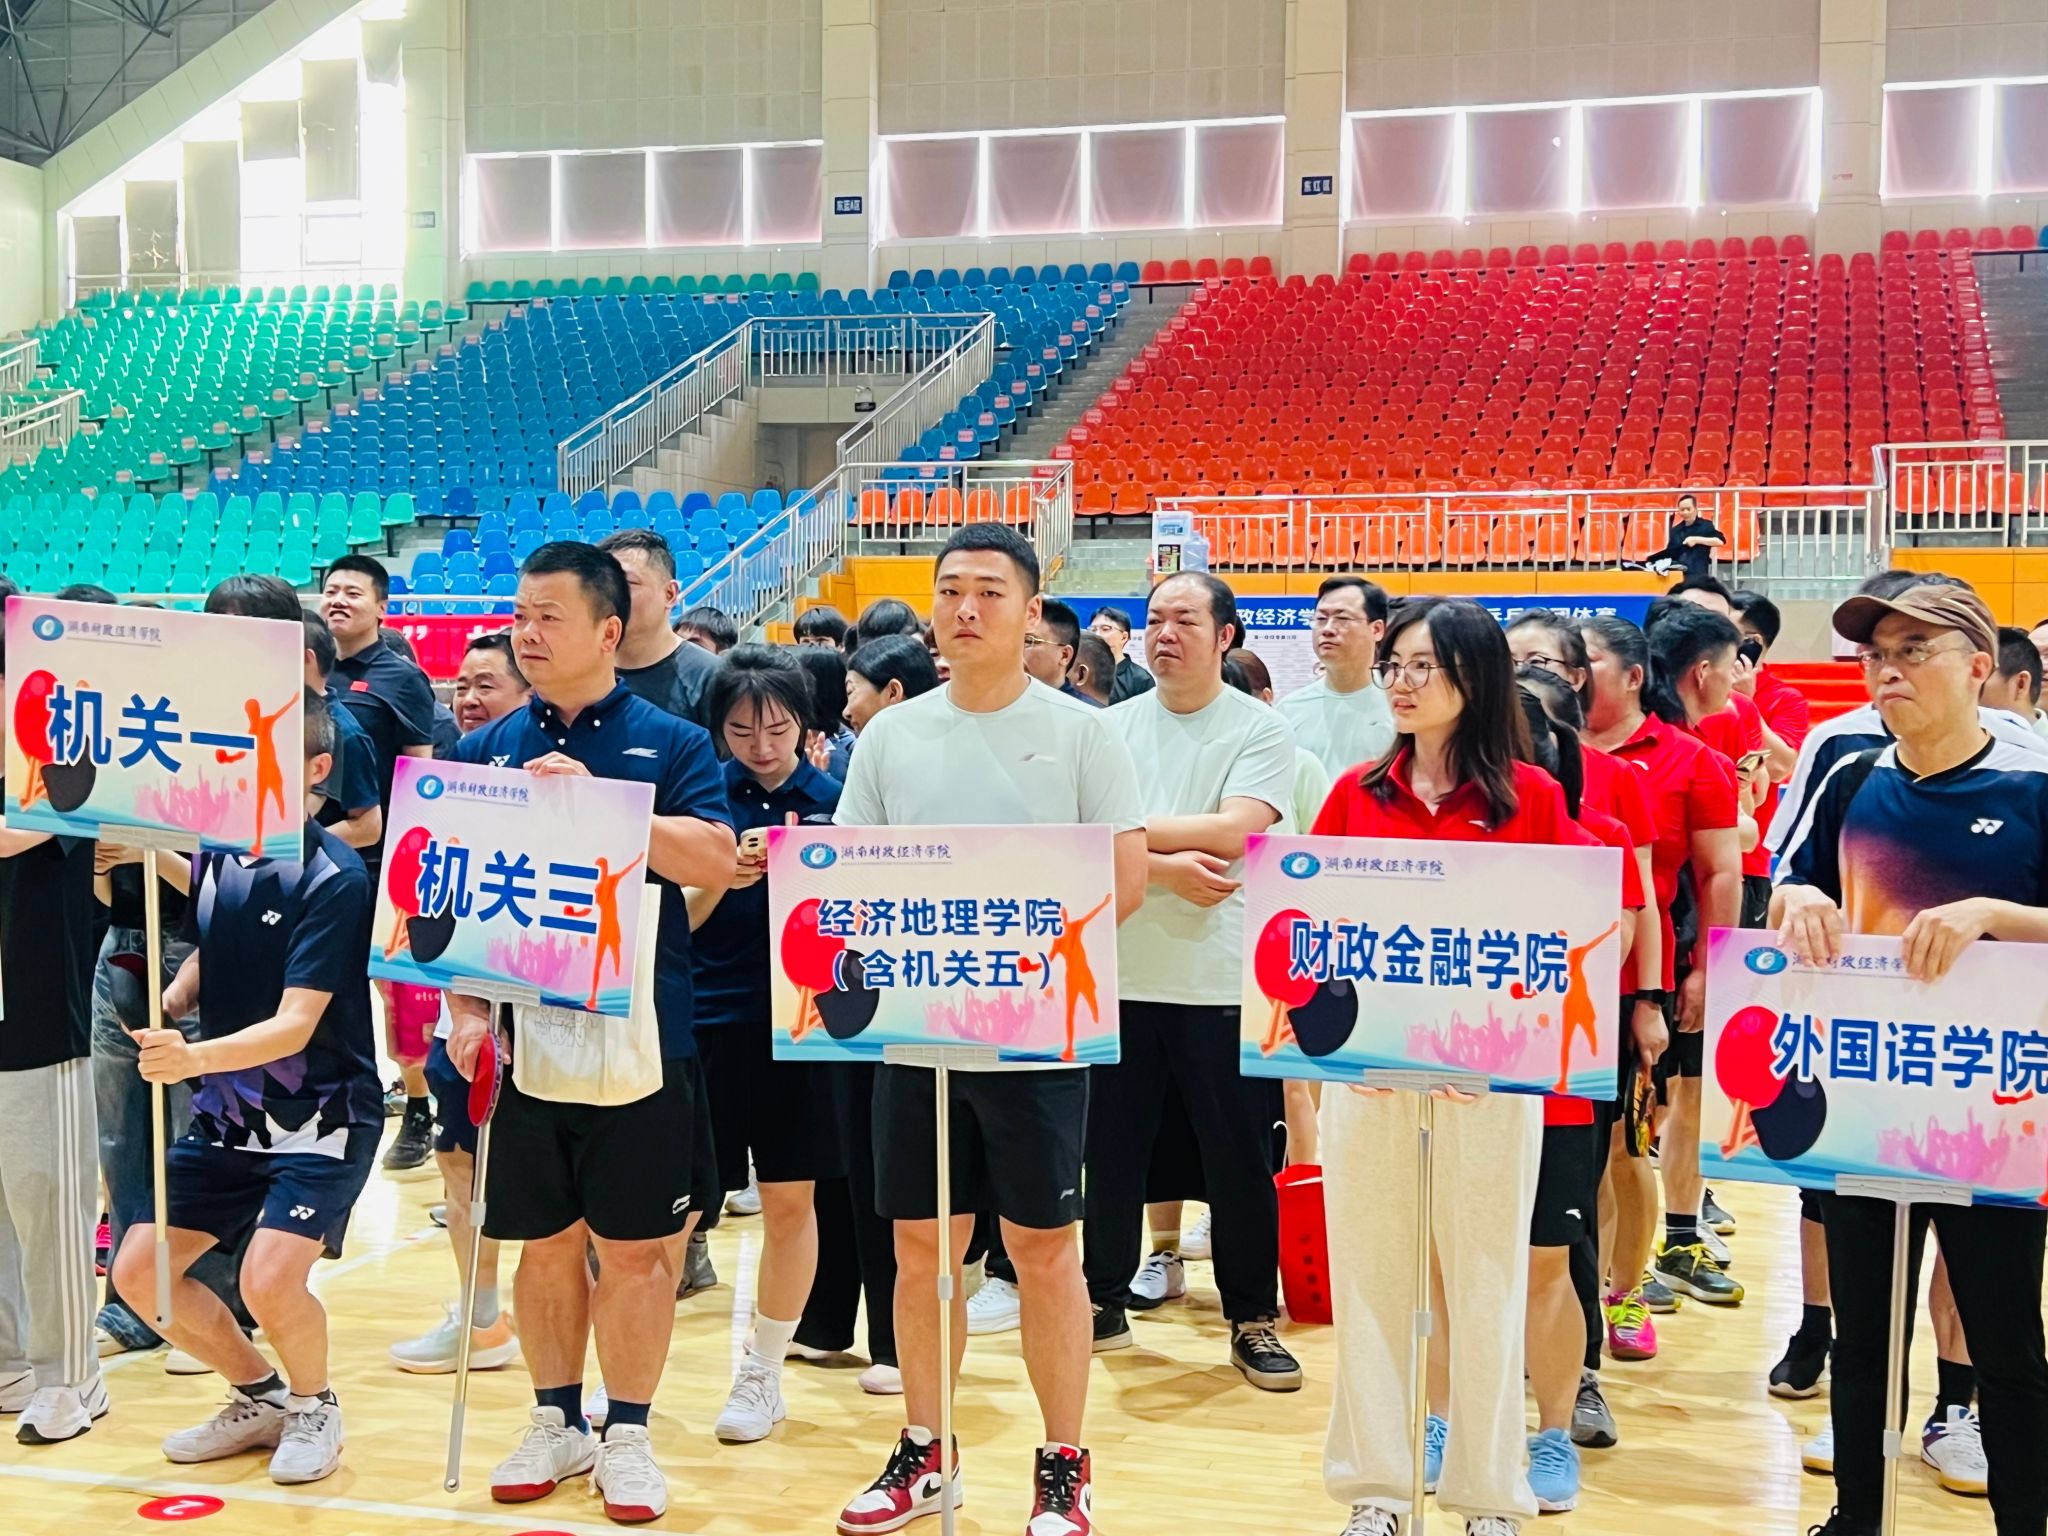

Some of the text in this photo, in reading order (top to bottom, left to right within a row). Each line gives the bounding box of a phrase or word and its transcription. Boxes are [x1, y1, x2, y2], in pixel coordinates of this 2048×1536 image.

[48, 684, 255, 774] 机关一
[417, 840, 600, 935] 机关三
[818, 897, 1064, 937] 经济地理学院
[833, 948, 1050, 990] （含机关五）
[1289, 919, 1569, 993] 财政金融学院
[1772, 1012, 2048, 1094] 外国语学院
